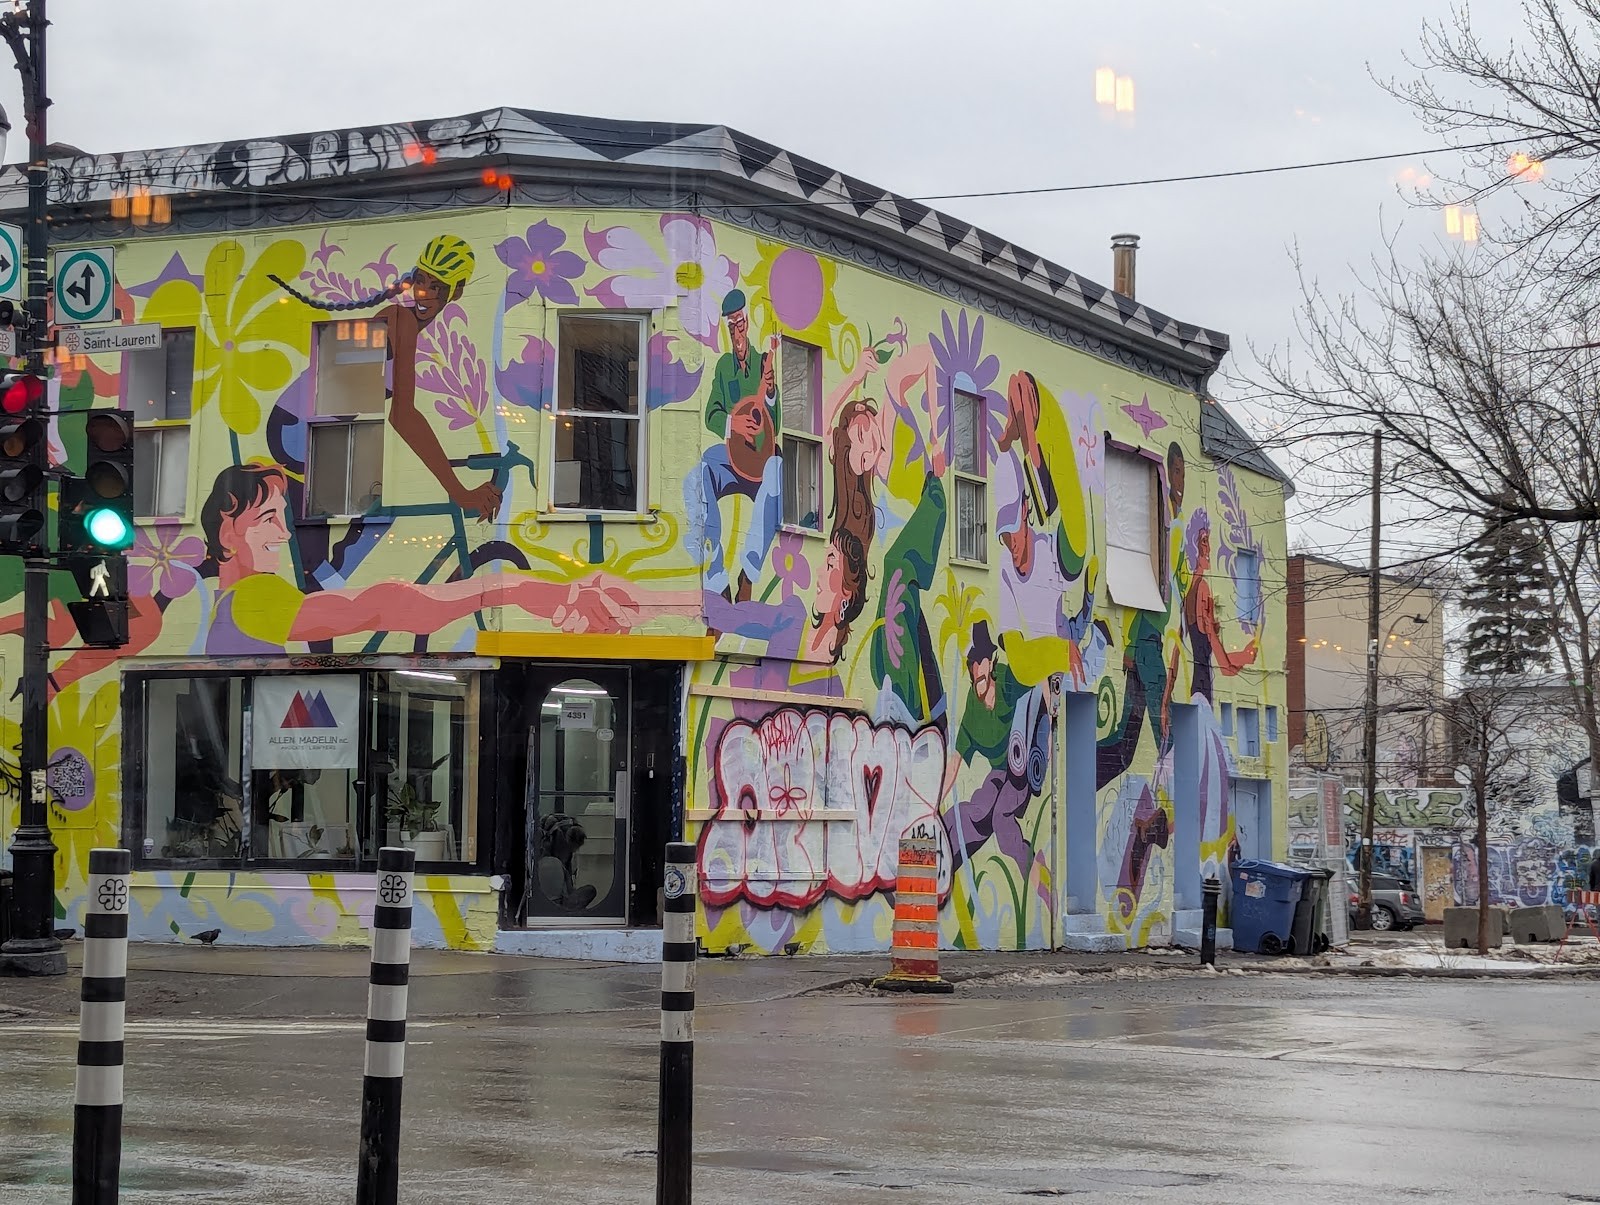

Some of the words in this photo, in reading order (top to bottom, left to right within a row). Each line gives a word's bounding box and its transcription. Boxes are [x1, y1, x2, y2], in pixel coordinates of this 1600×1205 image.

[84, 334, 156, 350] Saint-Laurent
[269, 736, 295, 744] ALLEN
[299, 736, 338, 744] MADELIN
